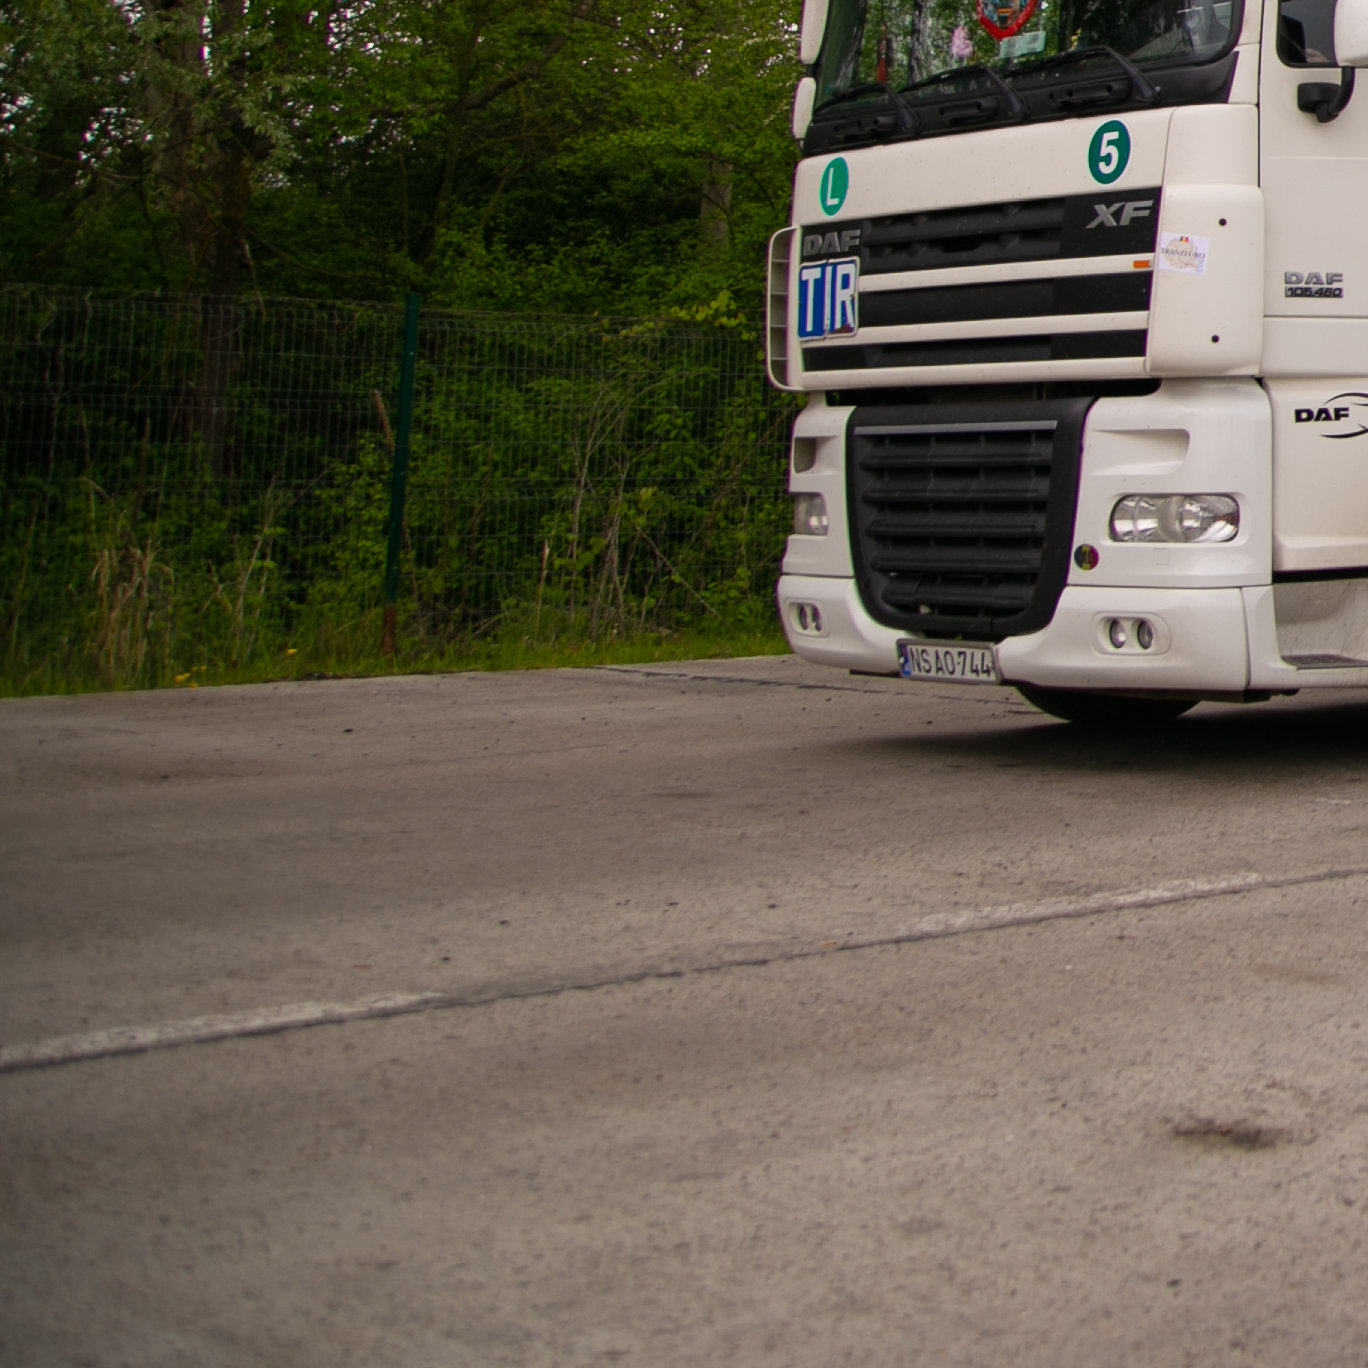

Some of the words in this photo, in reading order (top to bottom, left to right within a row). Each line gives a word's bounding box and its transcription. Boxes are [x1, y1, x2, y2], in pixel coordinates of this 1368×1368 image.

[1098, 131, 1120, 175] 5
[826, 167, 840, 206] L
[1085, 199, 1154, 229] XF
[803, 229, 861, 256] DAF
[1284, 271, 1343, 285] DAF
[801, 263, 855, 333] TIR
[1294, 407, 1350, 423] DAF
[910, 647, 932, 674] NS
